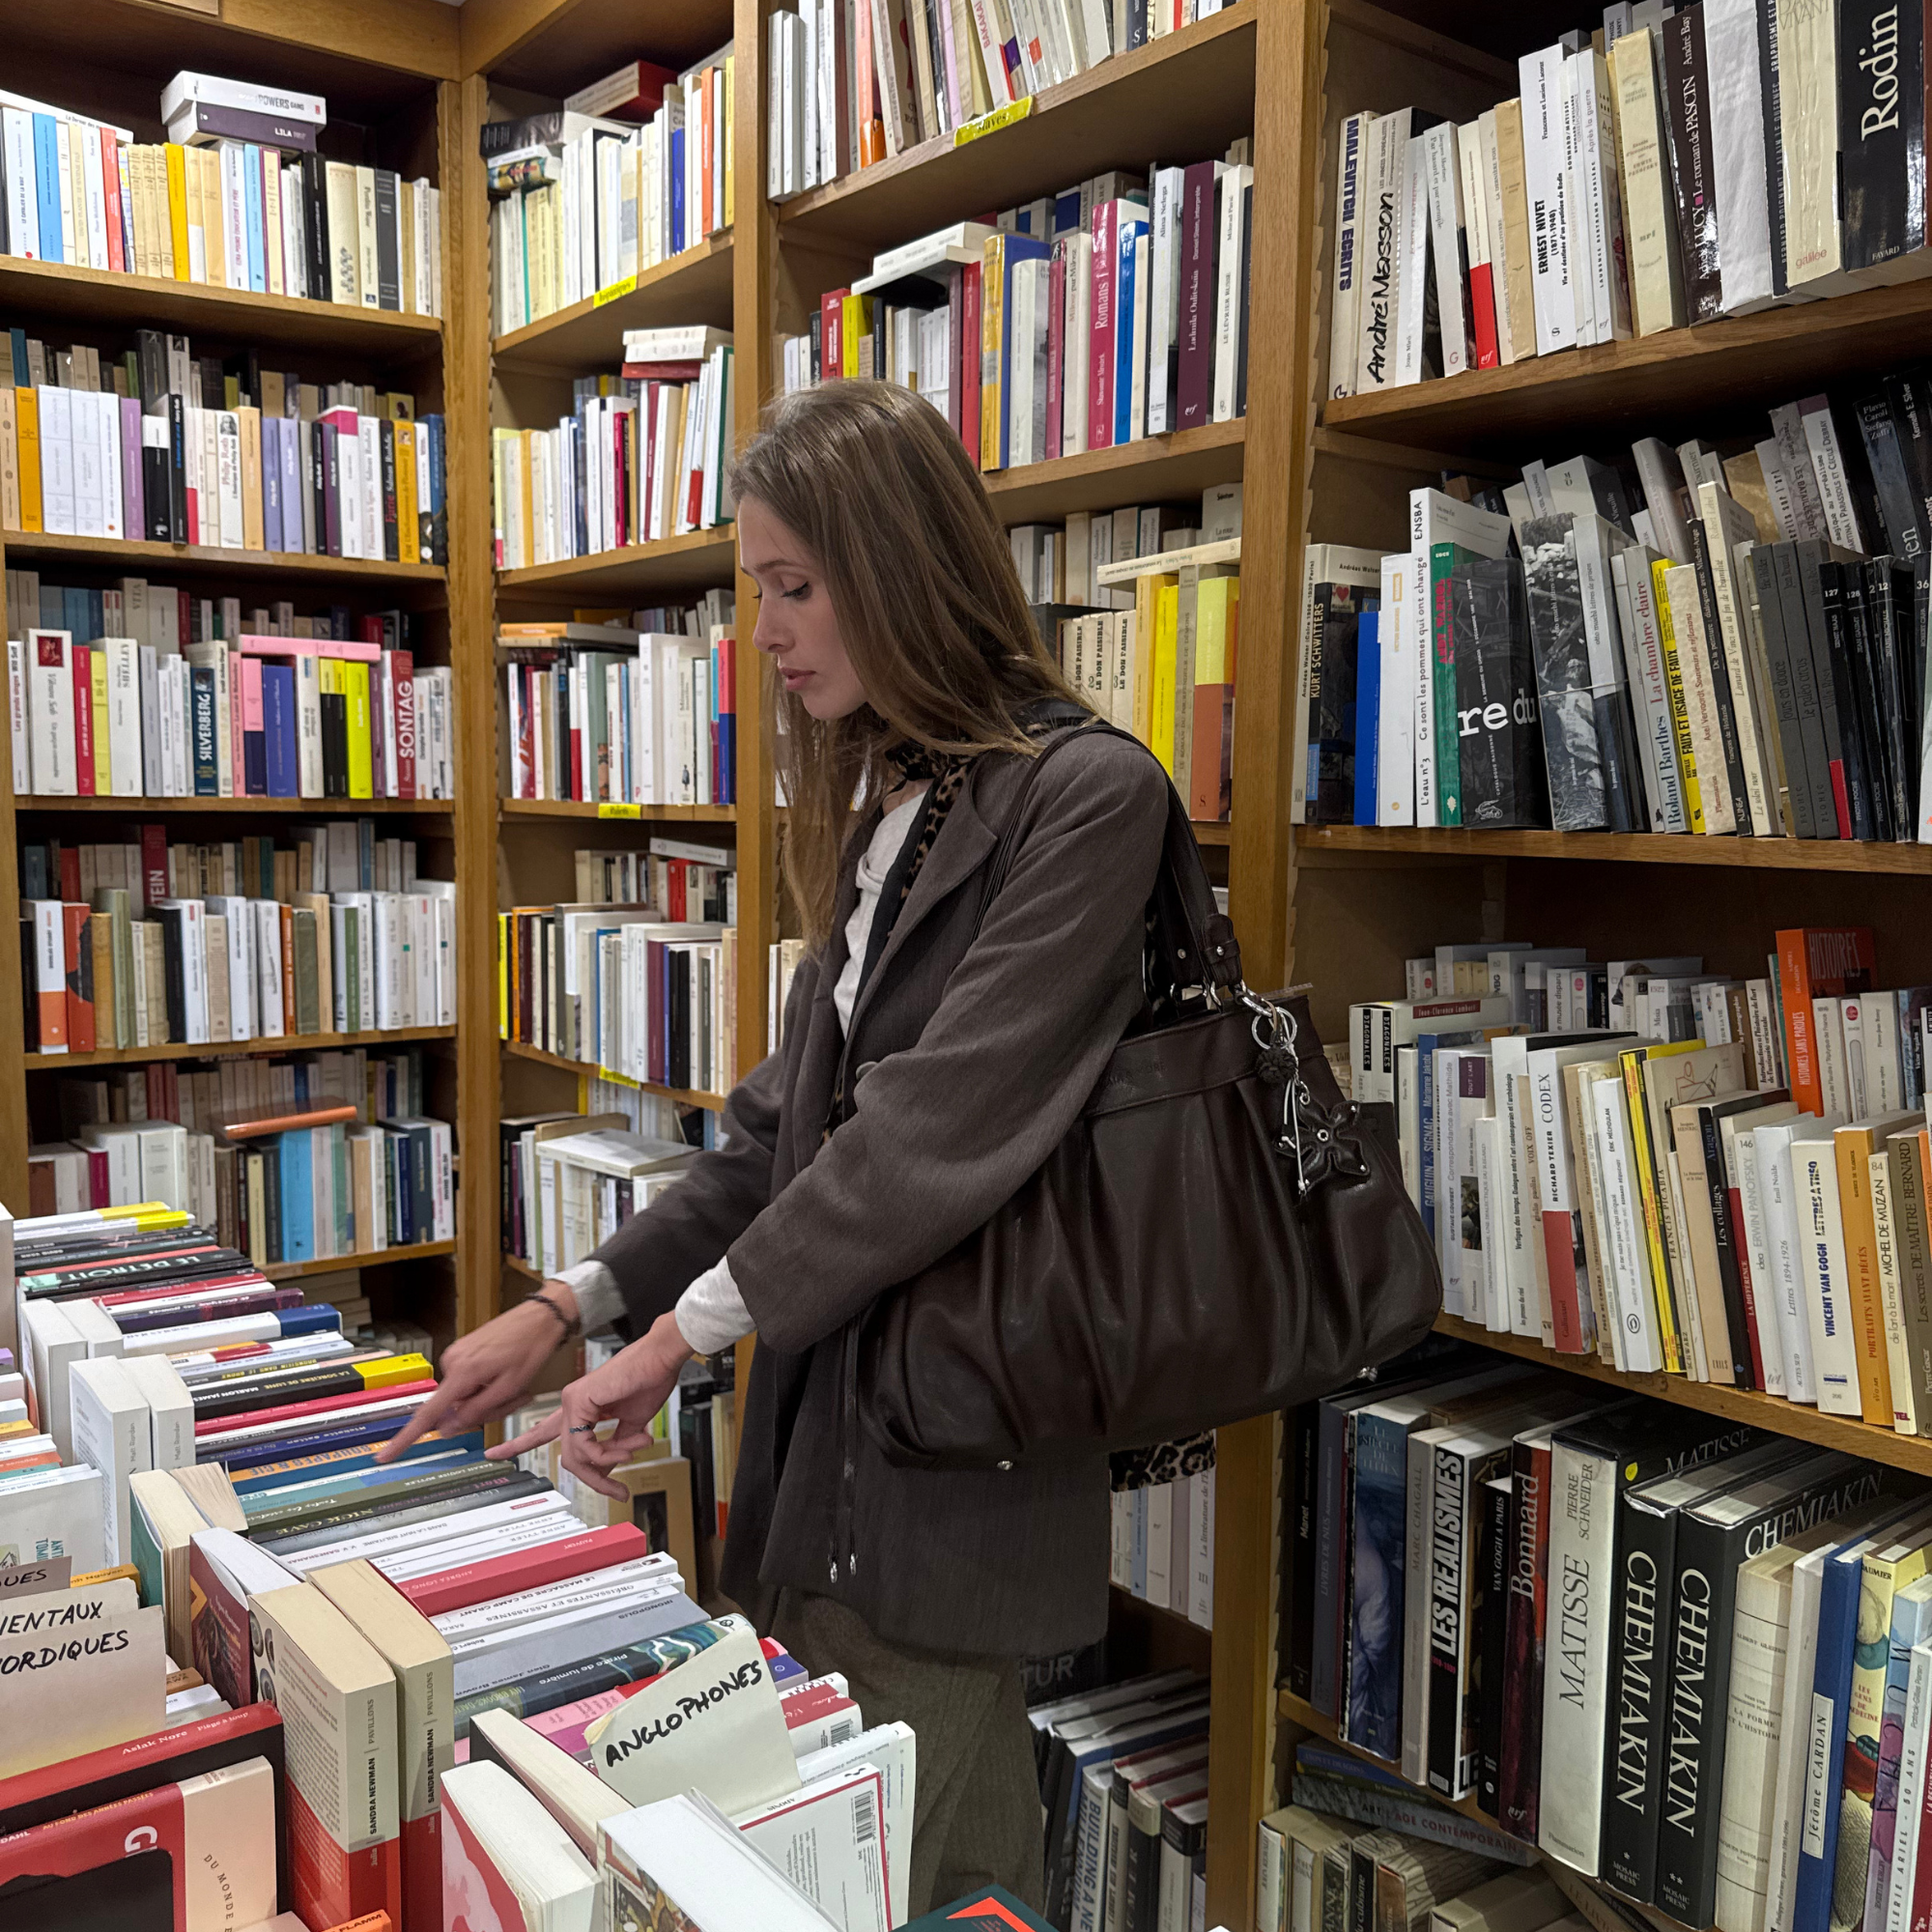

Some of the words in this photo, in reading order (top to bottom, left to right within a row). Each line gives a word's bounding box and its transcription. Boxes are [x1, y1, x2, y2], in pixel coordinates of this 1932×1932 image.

[1681, 15, 1693, 36] Bay
[1767, 6, 1777, 18] ET
[1681, 37, 1693, 66] André
[1768, 19, 1780, 72] GRAPHISME
[1859, 3, 1899, 142] Rodin
[1538, 83, 1548, 104] Lucien
[1583, 89, 1596, 116] guerre
[1540, 112, 1549, 140] Francesca
[1584, 118, 1594, 128] la
[1584, 128, 1596, 154] Après
[1534, 199, 1548, 233] NIVET
[1370, 191, 1394, 300] Masson
[1548, 209, 1560, 258] (1871-1948)
[1536, 234, 1550, 275] ERNEST
[1871, 244, 1901, 261] FAYARD
[1094, 281, 1110, 329] Romans
[1365, 299, 1389, 384] André
[1412, 501, 1424, 540] ENSBA
[1690, 528, 1705, 572] Michel-Ange
[1413, 555, 1427, 594] changé
[1698, 571, 1707, 587] avec
[1916, 580, 1929, 590] 36
[1415, 596, 1425, 616] ont
[1435, 579, 1447, 628] WARHOL
[1634, 581, 1653, 618] claire
[1700, 588, 1714, 619] dialogues
[1823, 589, 1838, 598] 127
[1846, 590, 1861, 599] 128
[1094, 619, 1104, 659] PAISIBLE
[1311, 602, 1324, 668] SCHWITTERS
[1415, 617, 1428, 636] qui
[1706, 624, 1719, 650] peinture
[1073, 624, 1084, 663] PAISIBLE
[1435, 632, 1448, 665] ANDY
[1640, 621, 1661, 690] chambre
[1074, 663, 1083, 682] DON
[1094, 659, 1103, 677] DON
[1417, 638, 1430, 681] pommes
[1665, 648, 1682, 671] FAUX
[1094, 678, 1102, 691] LE
[1311, 670, 1321, 697] KURT
[1415, 683, 1427, 698] les
[1670, 673, 1684, 686] DE
[1417, 700, 1428, 724] sont
[1456, 702, 1509, 738] re
[1512, 687, 1538, 725] du
[1649, 692, 1663, 705] La
[1672, 687, 1688, 718] USAGE
[197, 693, 213, 761] SILVERBERG
[1678, 718, 1690, 731] ET
[1719, 703, 1730, 731] Hollande
[1418, 725, 1429, 741] Ce
[1654, 715, 1674, 771] Barthes
[1678, 731, 1693, 755] FAUX
[1722, 731, 1732, 740] de
[1724, 740, 1736, 765] François
[1419, 777, 1430, 806] L'eau
[1661, 774, 1683, 825] Roland
[1807, 931, 1862, 980] HISTOIRES
[1792, 1010, 1806, 1038] PAROLES
[1382, 1016, 1391, 1067] DIAGONALES
[1795, 1037, 1808, 1054] SANS
[1794, 1055, 1811, 1086] HISTOIRES
[1537, 1072, 1554, 1124] CODEX
[1524, 1125, 1534, 1142] OFF
[1545, 1130, 1557, 1162] TEXIER
[1702, 1123, 1718, 1162] Aragon
[1739, 1140, 1754, 1151] 146
[1525, 1143, 1535, 1164] VOIX
[1548, 1162, 1559, 1203] RICHARD
[1743, 1158, 1759, 1212] PANOFSKY
[1897, 1143, 1916, 1202] BERNARD
[1528, 1176, 1540, 1200] paolini
[1530, 1201, 1542, 1222] giulio
[1711, 1184, 1726, 1227] collages
[1716, 1229, 1728, 1247] Les
[1749, 1213, 1764, 1248] ERWIN
[1904, 1204, 1921, 1251] MAÎTRE
[67, 1260, 172, 1282] DETROIT
[175, 1256, 201, 1266] LE
[1755, 1253, 1766, 1271] idea
[1779, 1239, 1793, 1285] 1894-1926
[1815, 1242, 1829, 1272] GOGH
[1855, 1245, 1869, 1275] DÉCÉS
[1910, 1253, 1923, 1270] DE
[1819, 1274, 1832, 1294] VAN
[1859, 1276, 1872, 1303] AVANT
[1914, 1272, 1925, 1306] secrets
[1785, 1288, 1798, 1317] Lettres
[1820, 1296, 1836, 1338] VINCENT
[1916, 1306, 1929, 1323] Les
[1860, 1304, 1878, 1359] PORTRAITS
[192, 1392, 221, 1403] JAMES
[220, 1386, 259, 1399] MARLON
[1411, 1465, 1423, 1535] CHAGALL
[1493, 1496, 1505, 1526] PARIS
[1566, 1473, 1578, 1521] PIERRE
[1577, 1463, 1594, 1541] SCHNEIDER
[274, 1520, 324, 1536] CAVE
[1298, 1505, 1311, 1540] Manet
[1320, 1516, 1331, 1542] NUS
[1432, 1450, 1463, 1605] REALISMES
[1494, 1526, 1504, 1536] A
[1509, 1470, 1541, 1602] Bonnard
[562, 1537, 594, 1550] PAUVERT
[1320, 1544, 1330, 1558] DE
[1410, 1537, 1422, 1574] MARC
[1492, 1538, 1505, 1570] GOGH
[533, 1577, 582, 1598] MASSACRE
[582, 1575, 596, 1584] LE
[1318, 1560, 1330, 1597] LIVRES
[1492, 1570, 1503, 1592] VAN
[457, 1604, 491, 1618] GRANT
[492, 1596, 521, 1609] CAMP
[617, 1599, 673, 1620] IRONOPOLIS
[1431, 1600, 1460, 1657] LES
[1558, 1553, 1590, 1710] MATISSE
[0, 1630, 129, 1675] ORDIQUES
[595, 1653, 628, 1668] Pirate
[538, 1668, 581, 1687] lumière
[581, 1663, 595, 1673] de
[1615, 1548, 1658, 1814] CHEMIAKIN
[425, 1671, 435, 1717] PAVILLONS
[1664, 1566, 1712, 1838] CHEMIAKIN
[366, 1698, 375, 1746] PAVILLONS
[605, 1660, 764, 1769] ANGLOPHONES
[425, 1728, 436, 1768] NEWMAN
[1811, 1713, 1828, 1780] CARDAN
[367, 1757, 378, 1799] NEWMAN
[426, 1768, 436, 1804] SANDRA
[368, 1798, 378, 1835] SANDRA
[1806, 1787, 1824, 1841] Jérôme
[217, 1872, 235, 1920] MONDE
